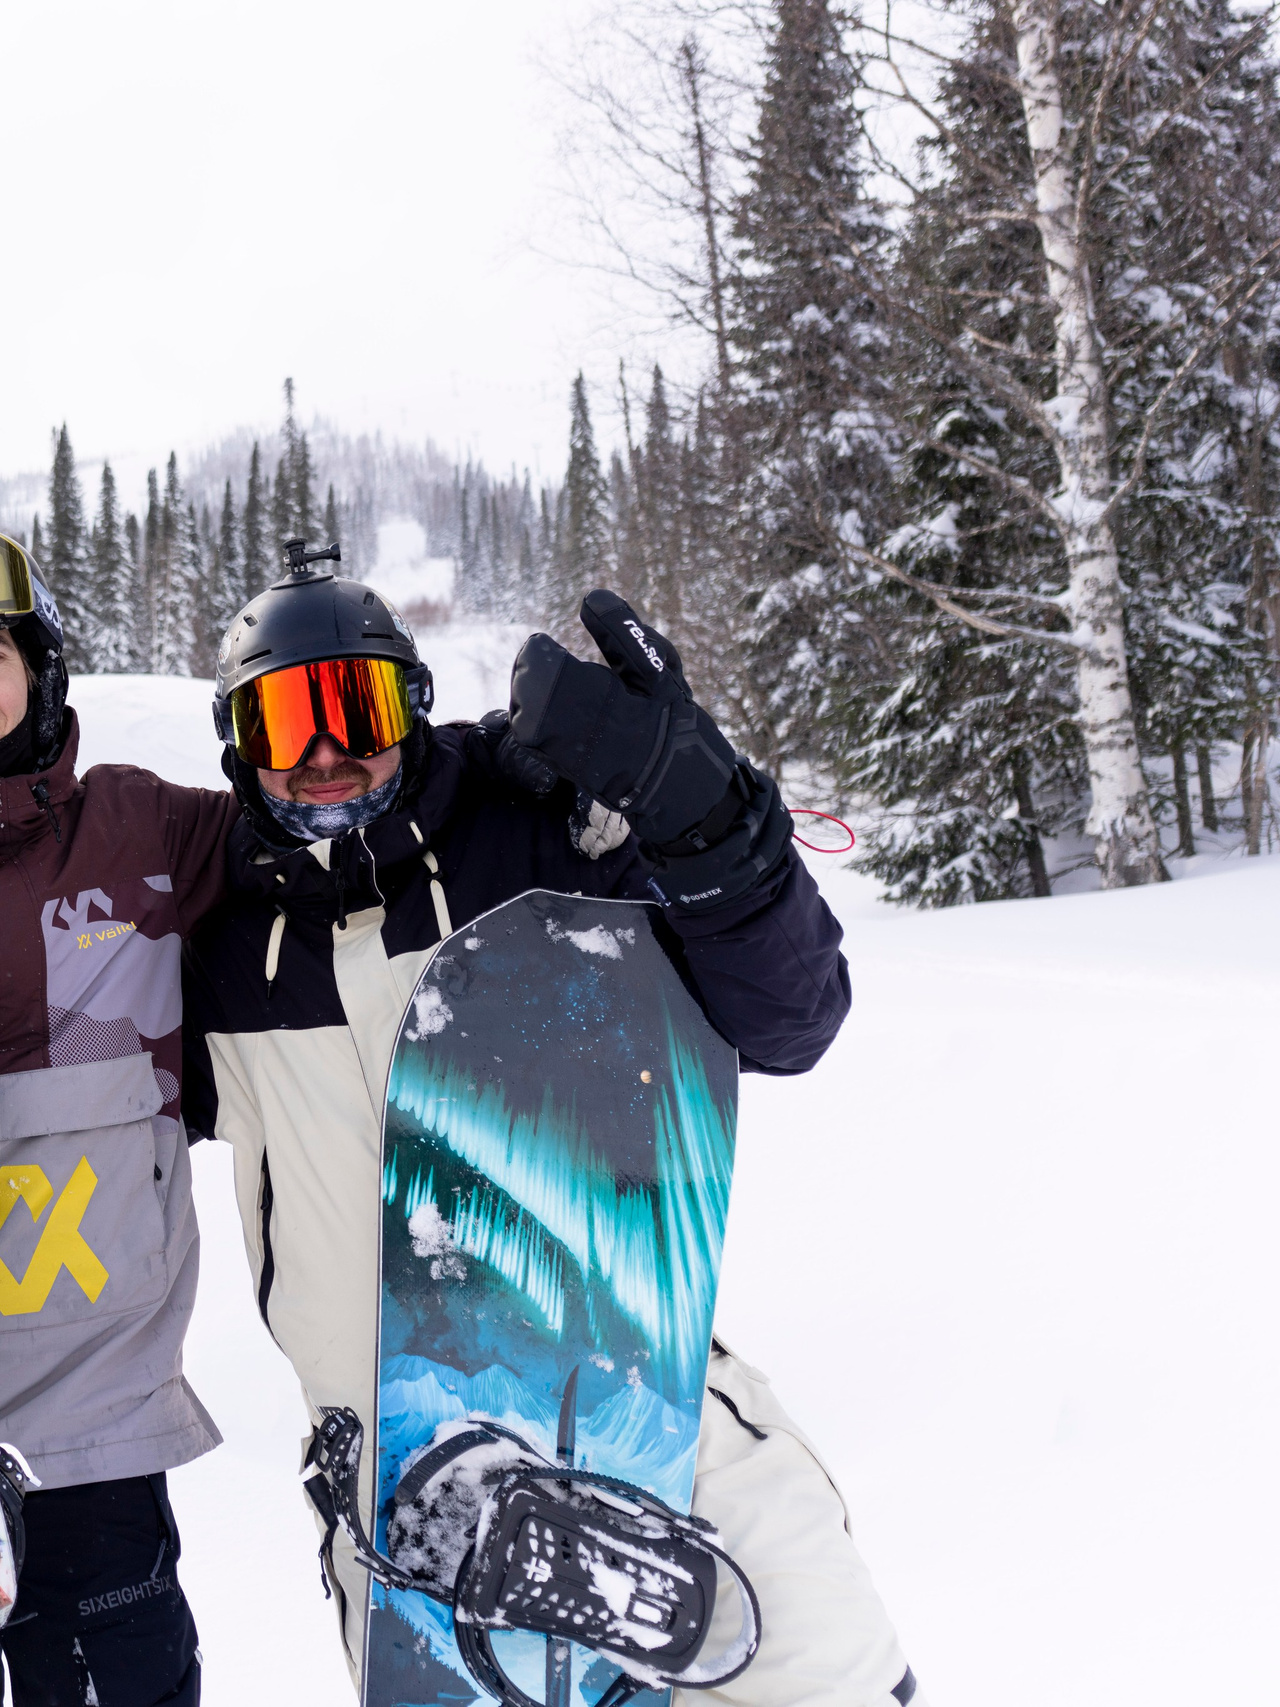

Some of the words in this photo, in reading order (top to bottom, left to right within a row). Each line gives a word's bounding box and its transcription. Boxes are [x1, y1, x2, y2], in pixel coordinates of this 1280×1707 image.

[623, 619, 664, 672] reusc
[689, 887, 723, 902] GORE-TEX
[95, 921, 137, 942] Völkl
[78, 1574, 175, 1616] SIXEIGHTSIX
